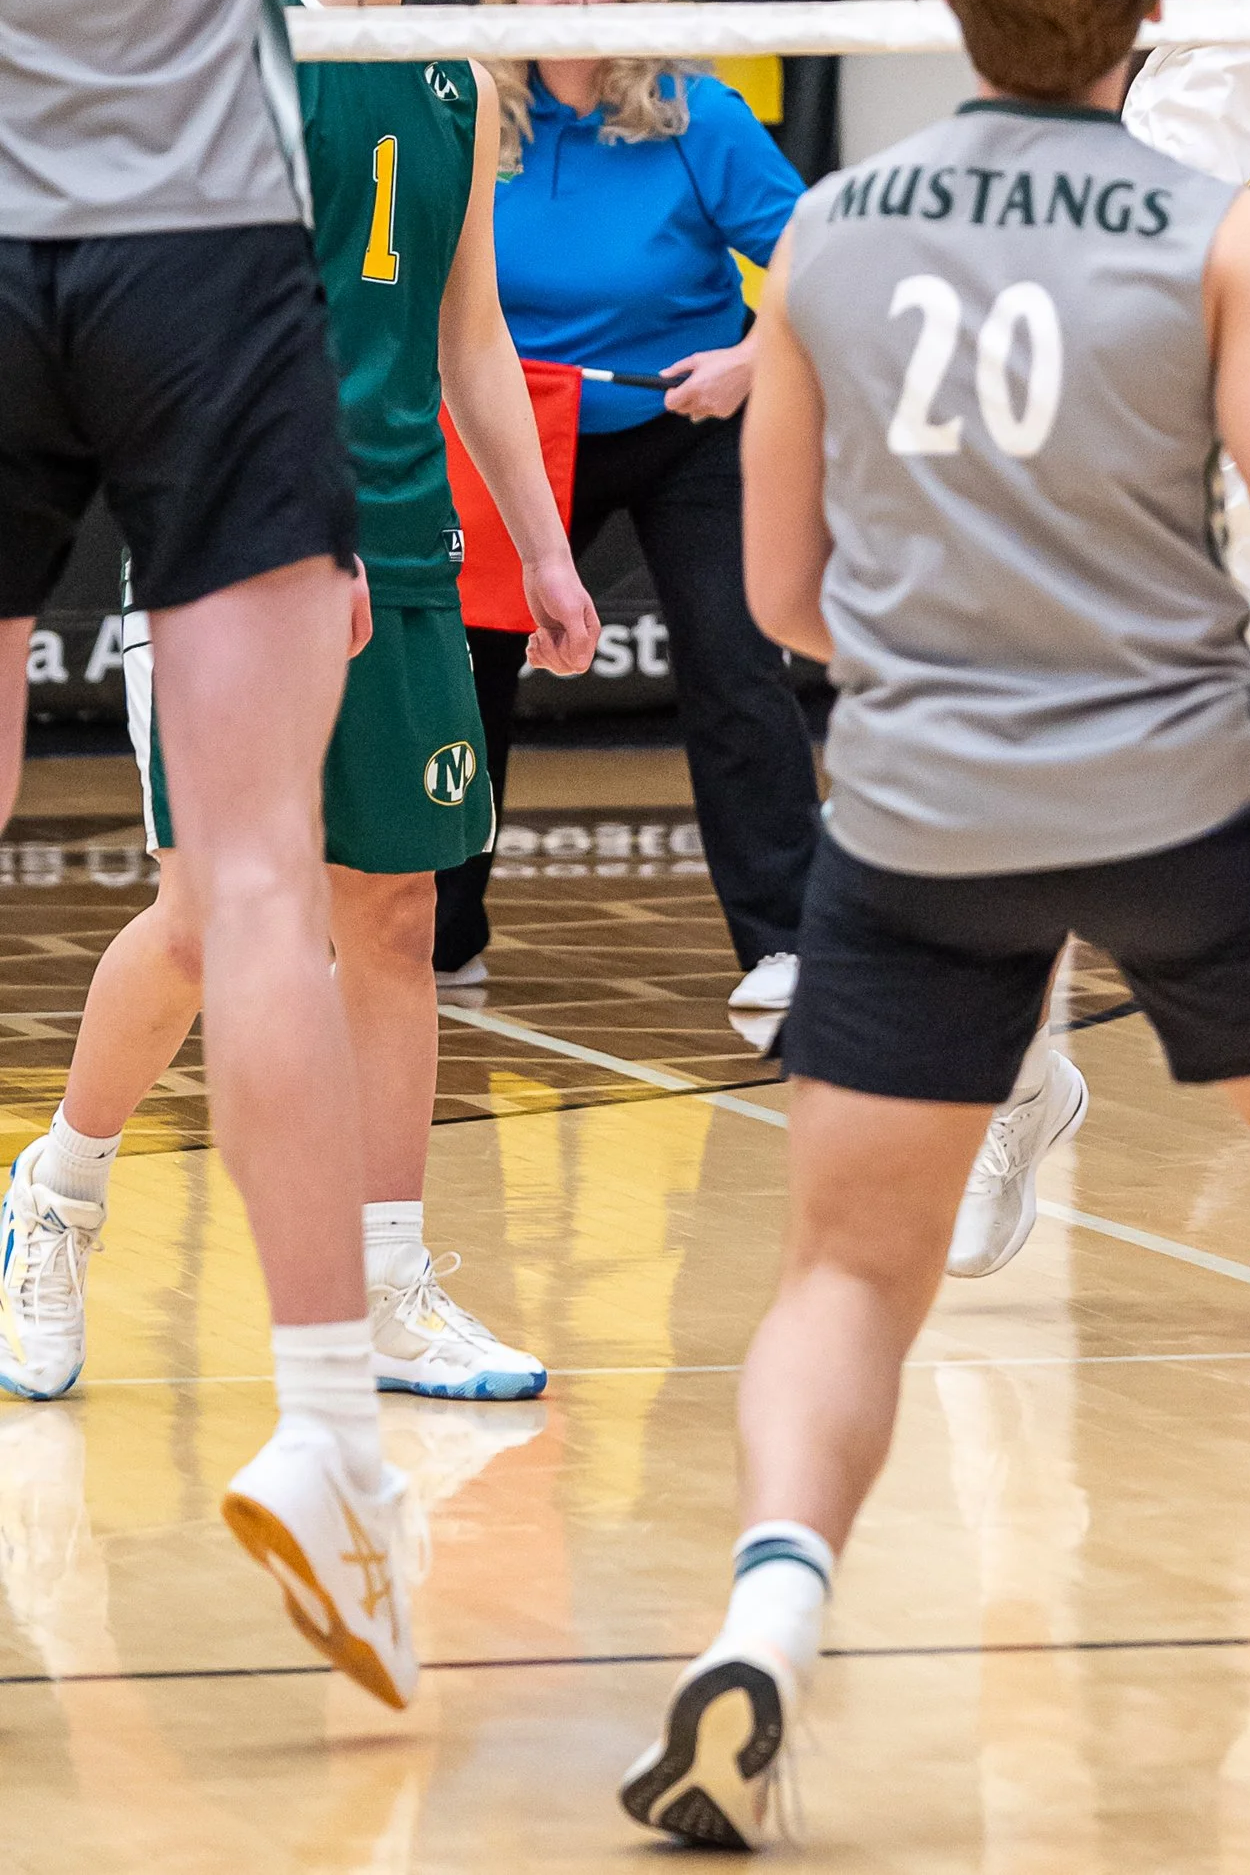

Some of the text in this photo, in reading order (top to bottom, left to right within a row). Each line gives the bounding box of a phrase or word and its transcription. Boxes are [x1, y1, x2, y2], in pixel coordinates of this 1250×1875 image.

[361, 134, 399, 285] 1
[828, 164, 1174, 238] MUSTANGS
[886, 273, 1064, 458] 20
